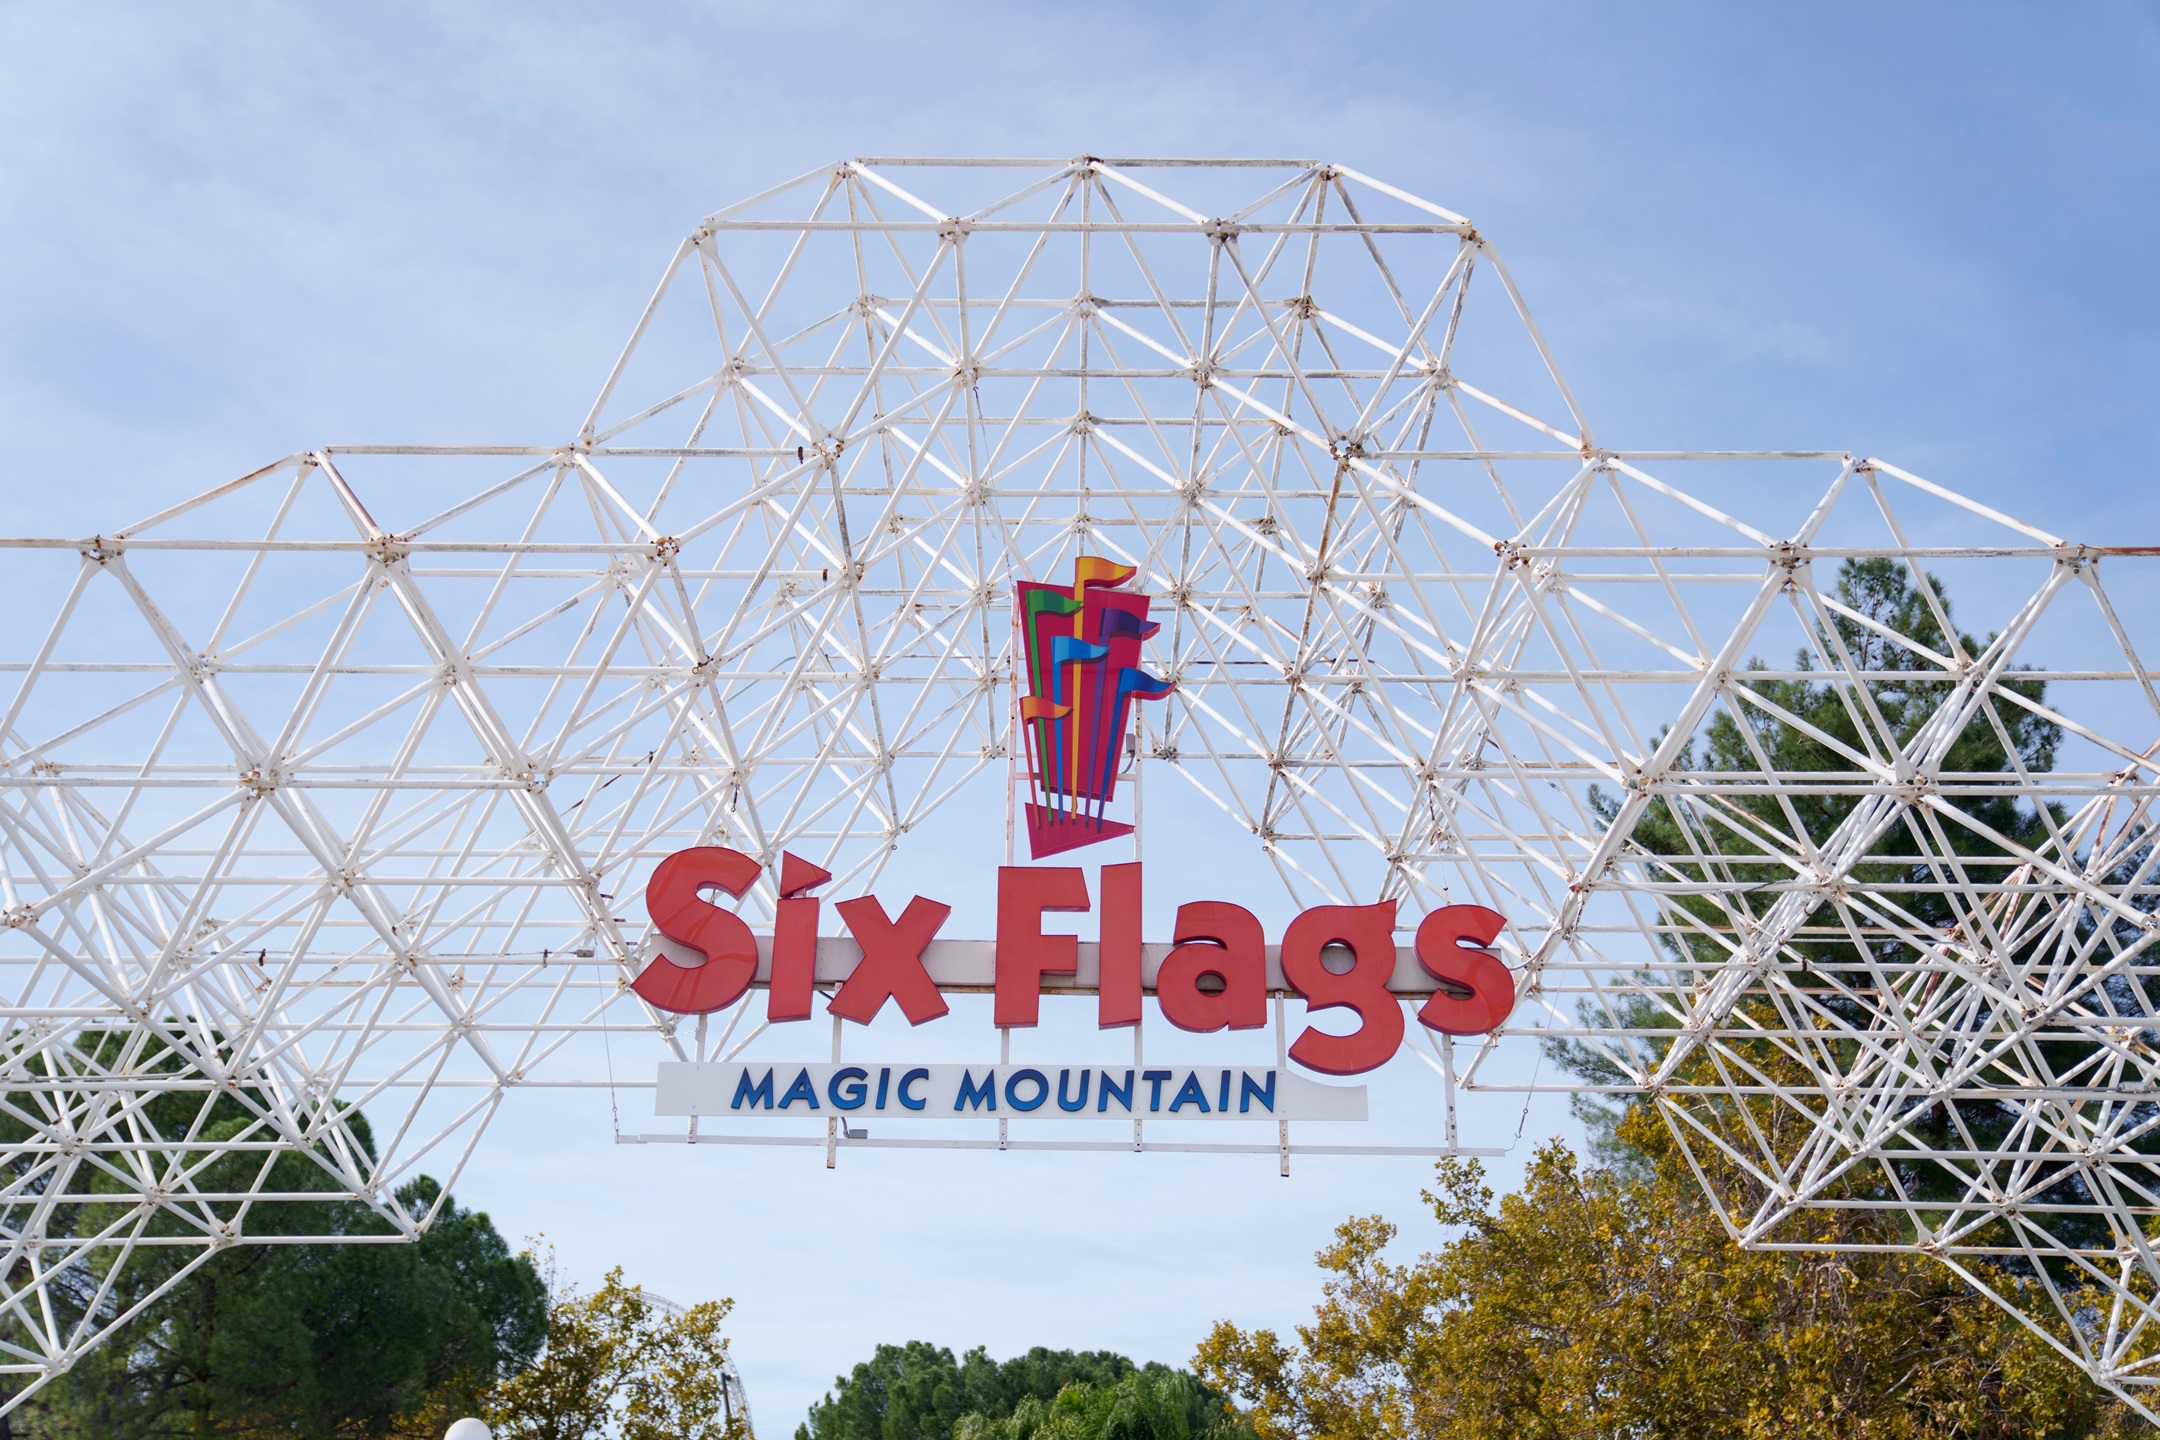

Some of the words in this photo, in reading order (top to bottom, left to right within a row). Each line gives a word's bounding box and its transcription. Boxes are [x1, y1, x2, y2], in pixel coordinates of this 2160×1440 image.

[631, 846, 951, 1026] Six
[993, 861, 1515, 1075] Flags
[730, 1066, 930, 1111] MAGIC
[953, 1068, 1277, 1113] MOUNTAIN
